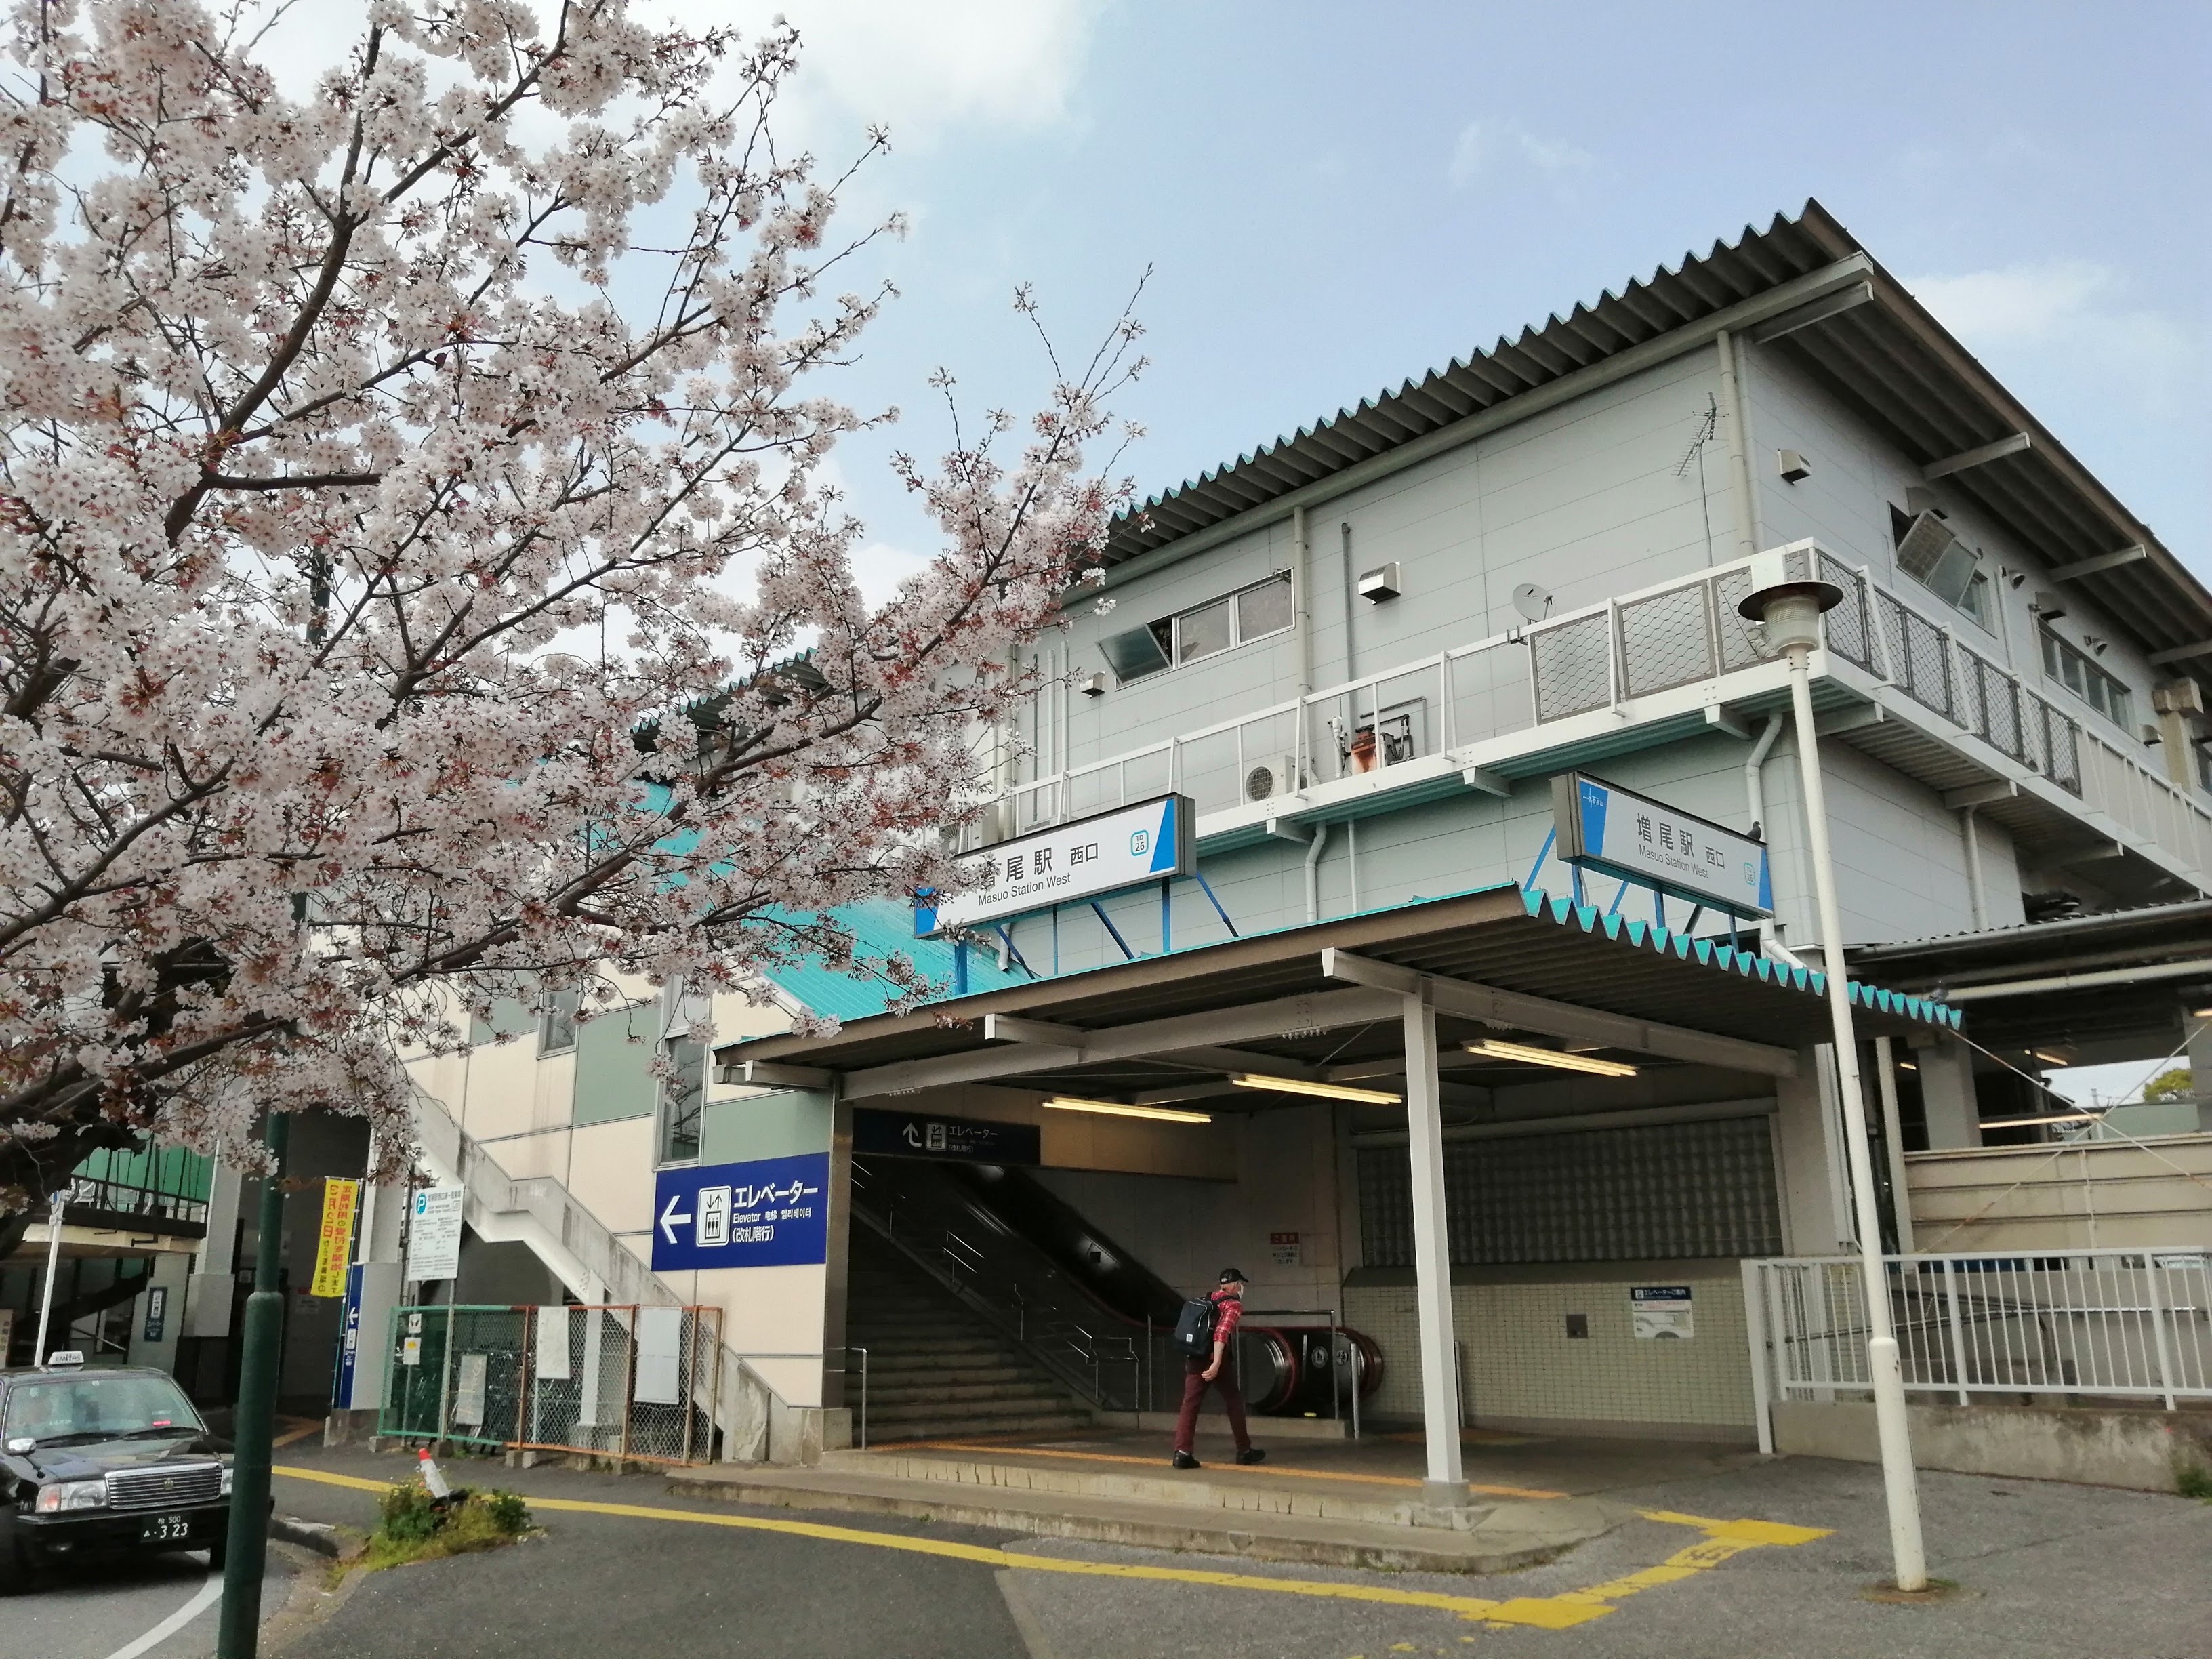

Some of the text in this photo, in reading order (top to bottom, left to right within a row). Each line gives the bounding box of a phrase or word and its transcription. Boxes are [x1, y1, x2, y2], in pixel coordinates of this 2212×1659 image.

[1135, 842, 1145, 852] 26
[1637, 813, 1725, 869] 増尾駅 西口
[987, 843, 1099, 887] 尾駅 西口
[1639, 844, 1708, 879] Masuo Station West
[978, 873, 1071, 906] Masuo Station West
[949, 1126, 998, 1139] エレベーター
[733, 1180, 819, 1208] エレベーター
[733, 1212, 761, 1224] Elevator
[781, 1207, 811, 1220] 엘리베이터
[733, 1225, 774, 1242] (改札階行)
[168, 1516, 181, 1524] 500
